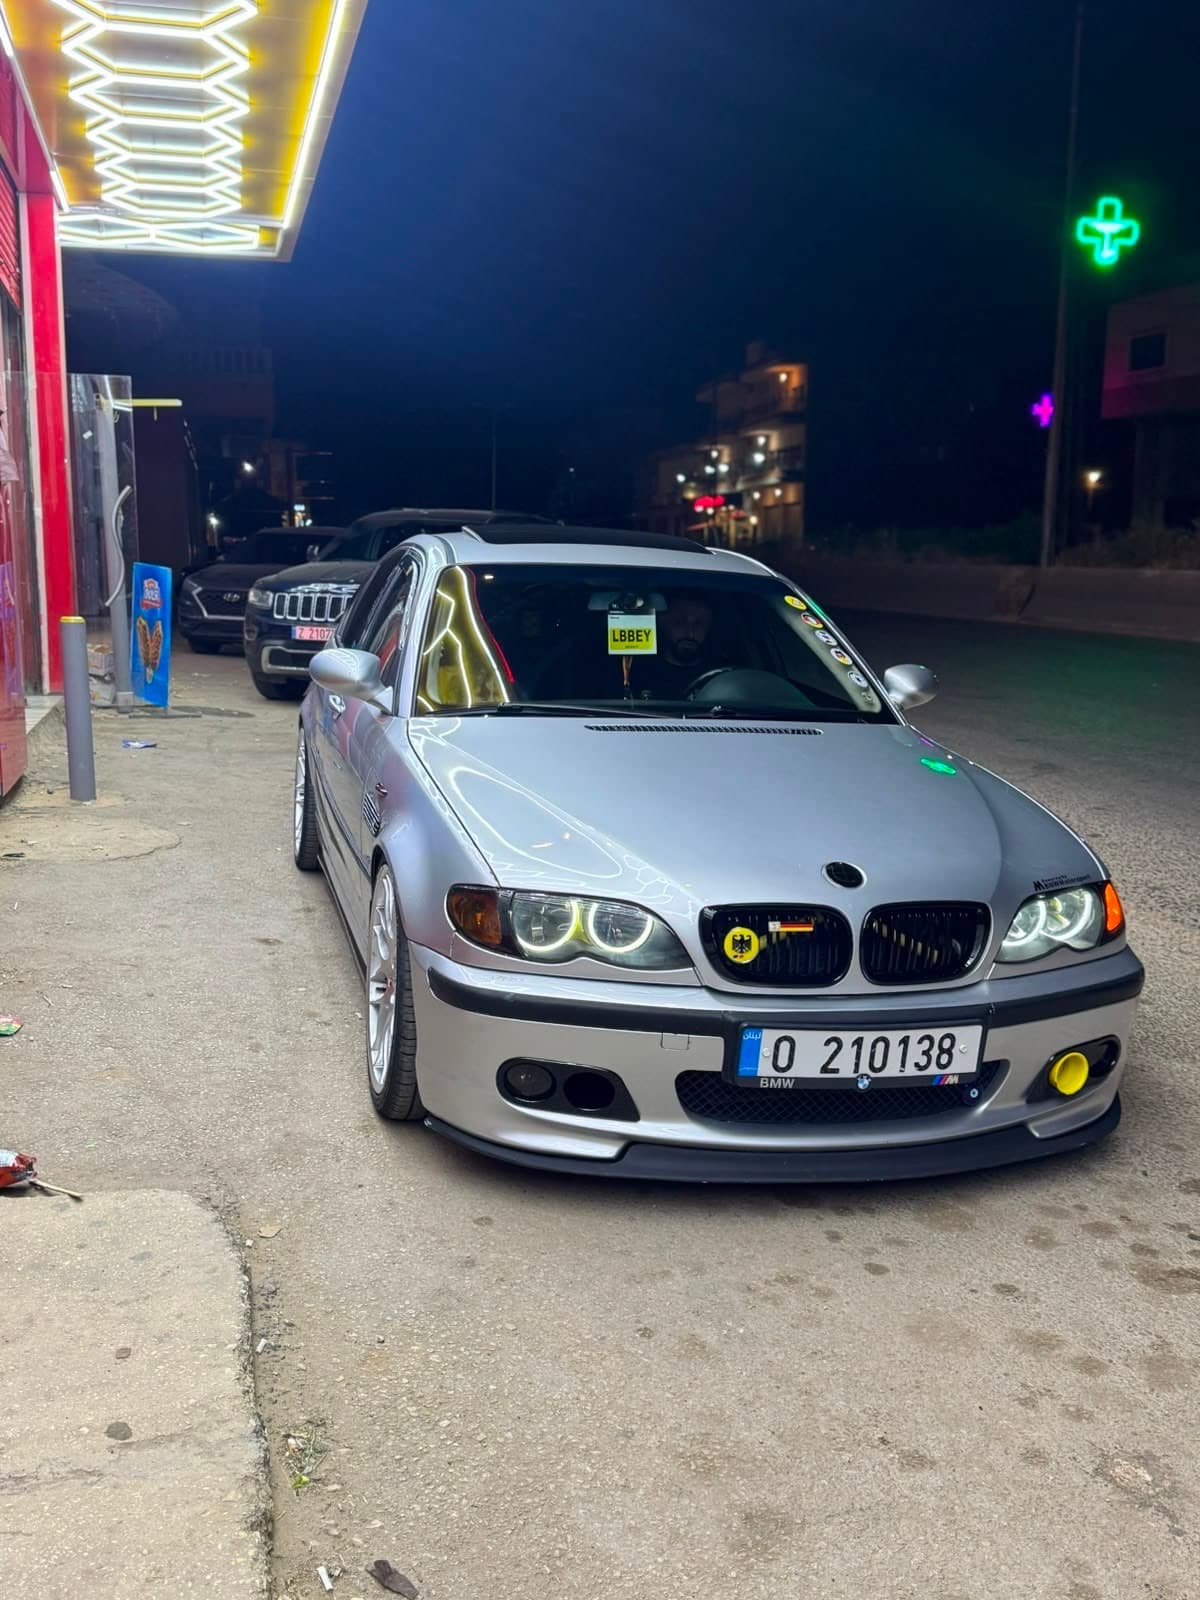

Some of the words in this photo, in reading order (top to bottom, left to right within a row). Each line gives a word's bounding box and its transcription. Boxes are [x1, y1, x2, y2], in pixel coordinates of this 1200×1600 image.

[298, 628, 304, 639] Z
[612, 629, 651, 642] LBBEY
[742, 1031, 761, 1040] لبنان
[819, 1032, 957, 1075] 210138
[759, 1077, 796, 1089] BMW
